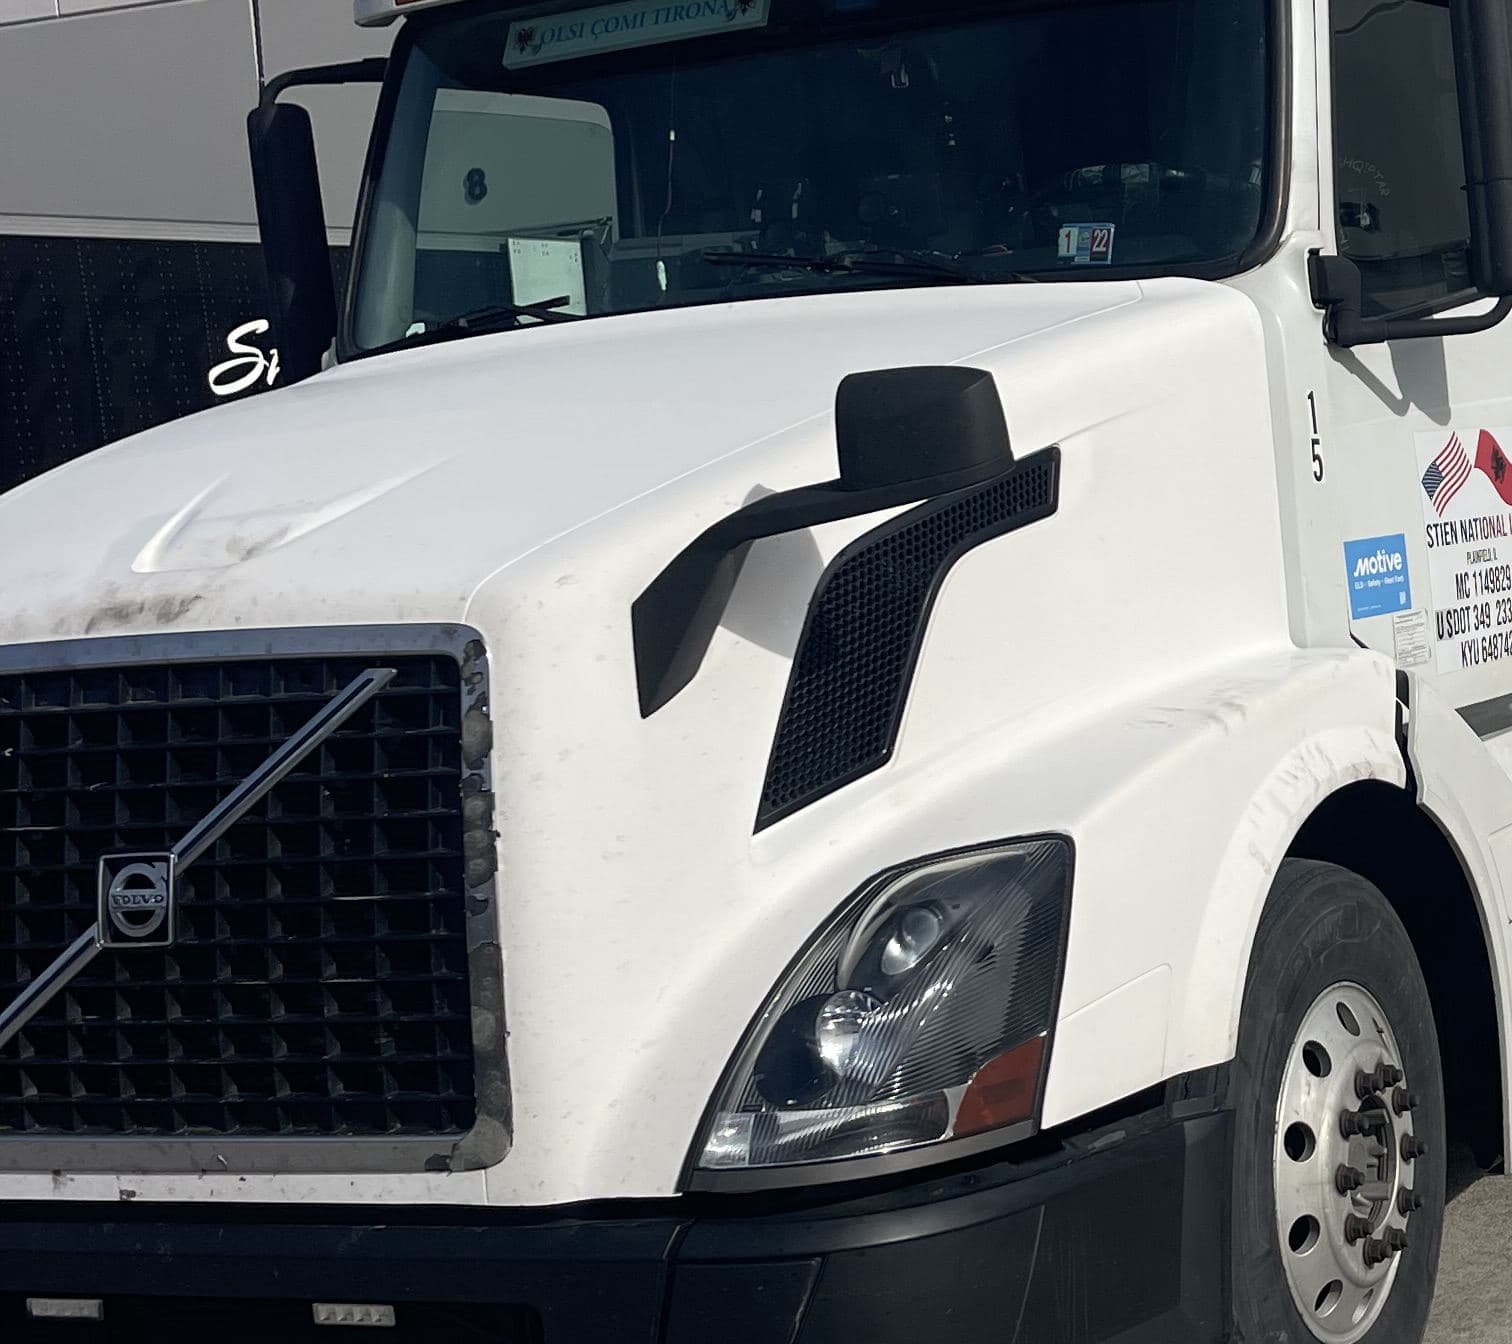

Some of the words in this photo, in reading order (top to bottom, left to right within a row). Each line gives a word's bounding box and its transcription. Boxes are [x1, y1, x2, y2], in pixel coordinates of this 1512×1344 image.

[1092, 229, 1109, 252] 22
[1307, 390, 1325, 483] 15
[1426, 520, 1459, 548] STIEN
[1460, 513, 1508, 543] NATIONAL
[1353, 549, 1403, 577] Motive
[1455, 571, 1471, 600] MC
[1472, 564, 1512, 597] 1149829
[1472, 601, 1491, 631] 349
[1461, 637, 1480, 668] KYU
[111, 893, 165, 906] VOLVO
